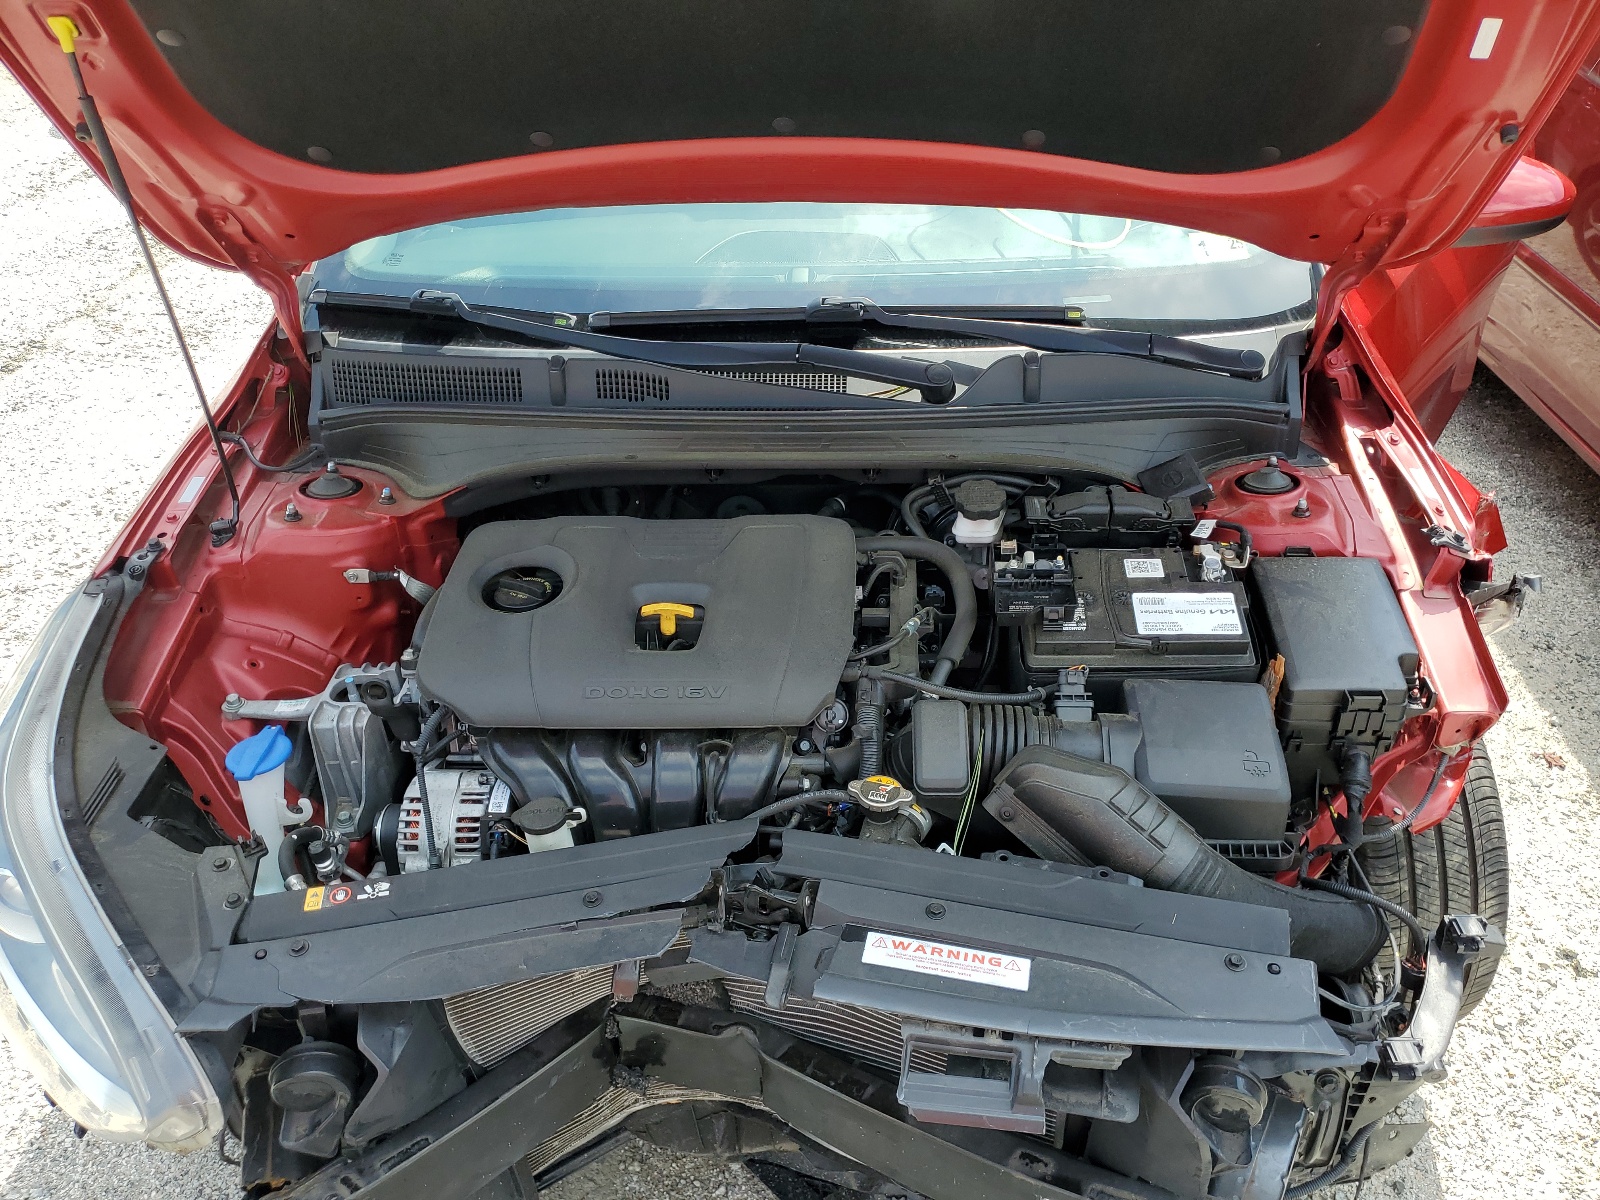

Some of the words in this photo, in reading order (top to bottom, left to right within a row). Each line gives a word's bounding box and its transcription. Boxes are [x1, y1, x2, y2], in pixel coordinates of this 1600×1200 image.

[1139, 608, 1174, 616] Batteries
[1174, 608, 1207, 616] Genuine
[584, 685, 669, 699] DOHC
[677, 685, 728, 699] 16V
[891, 939, 1002, 968] WARNING
